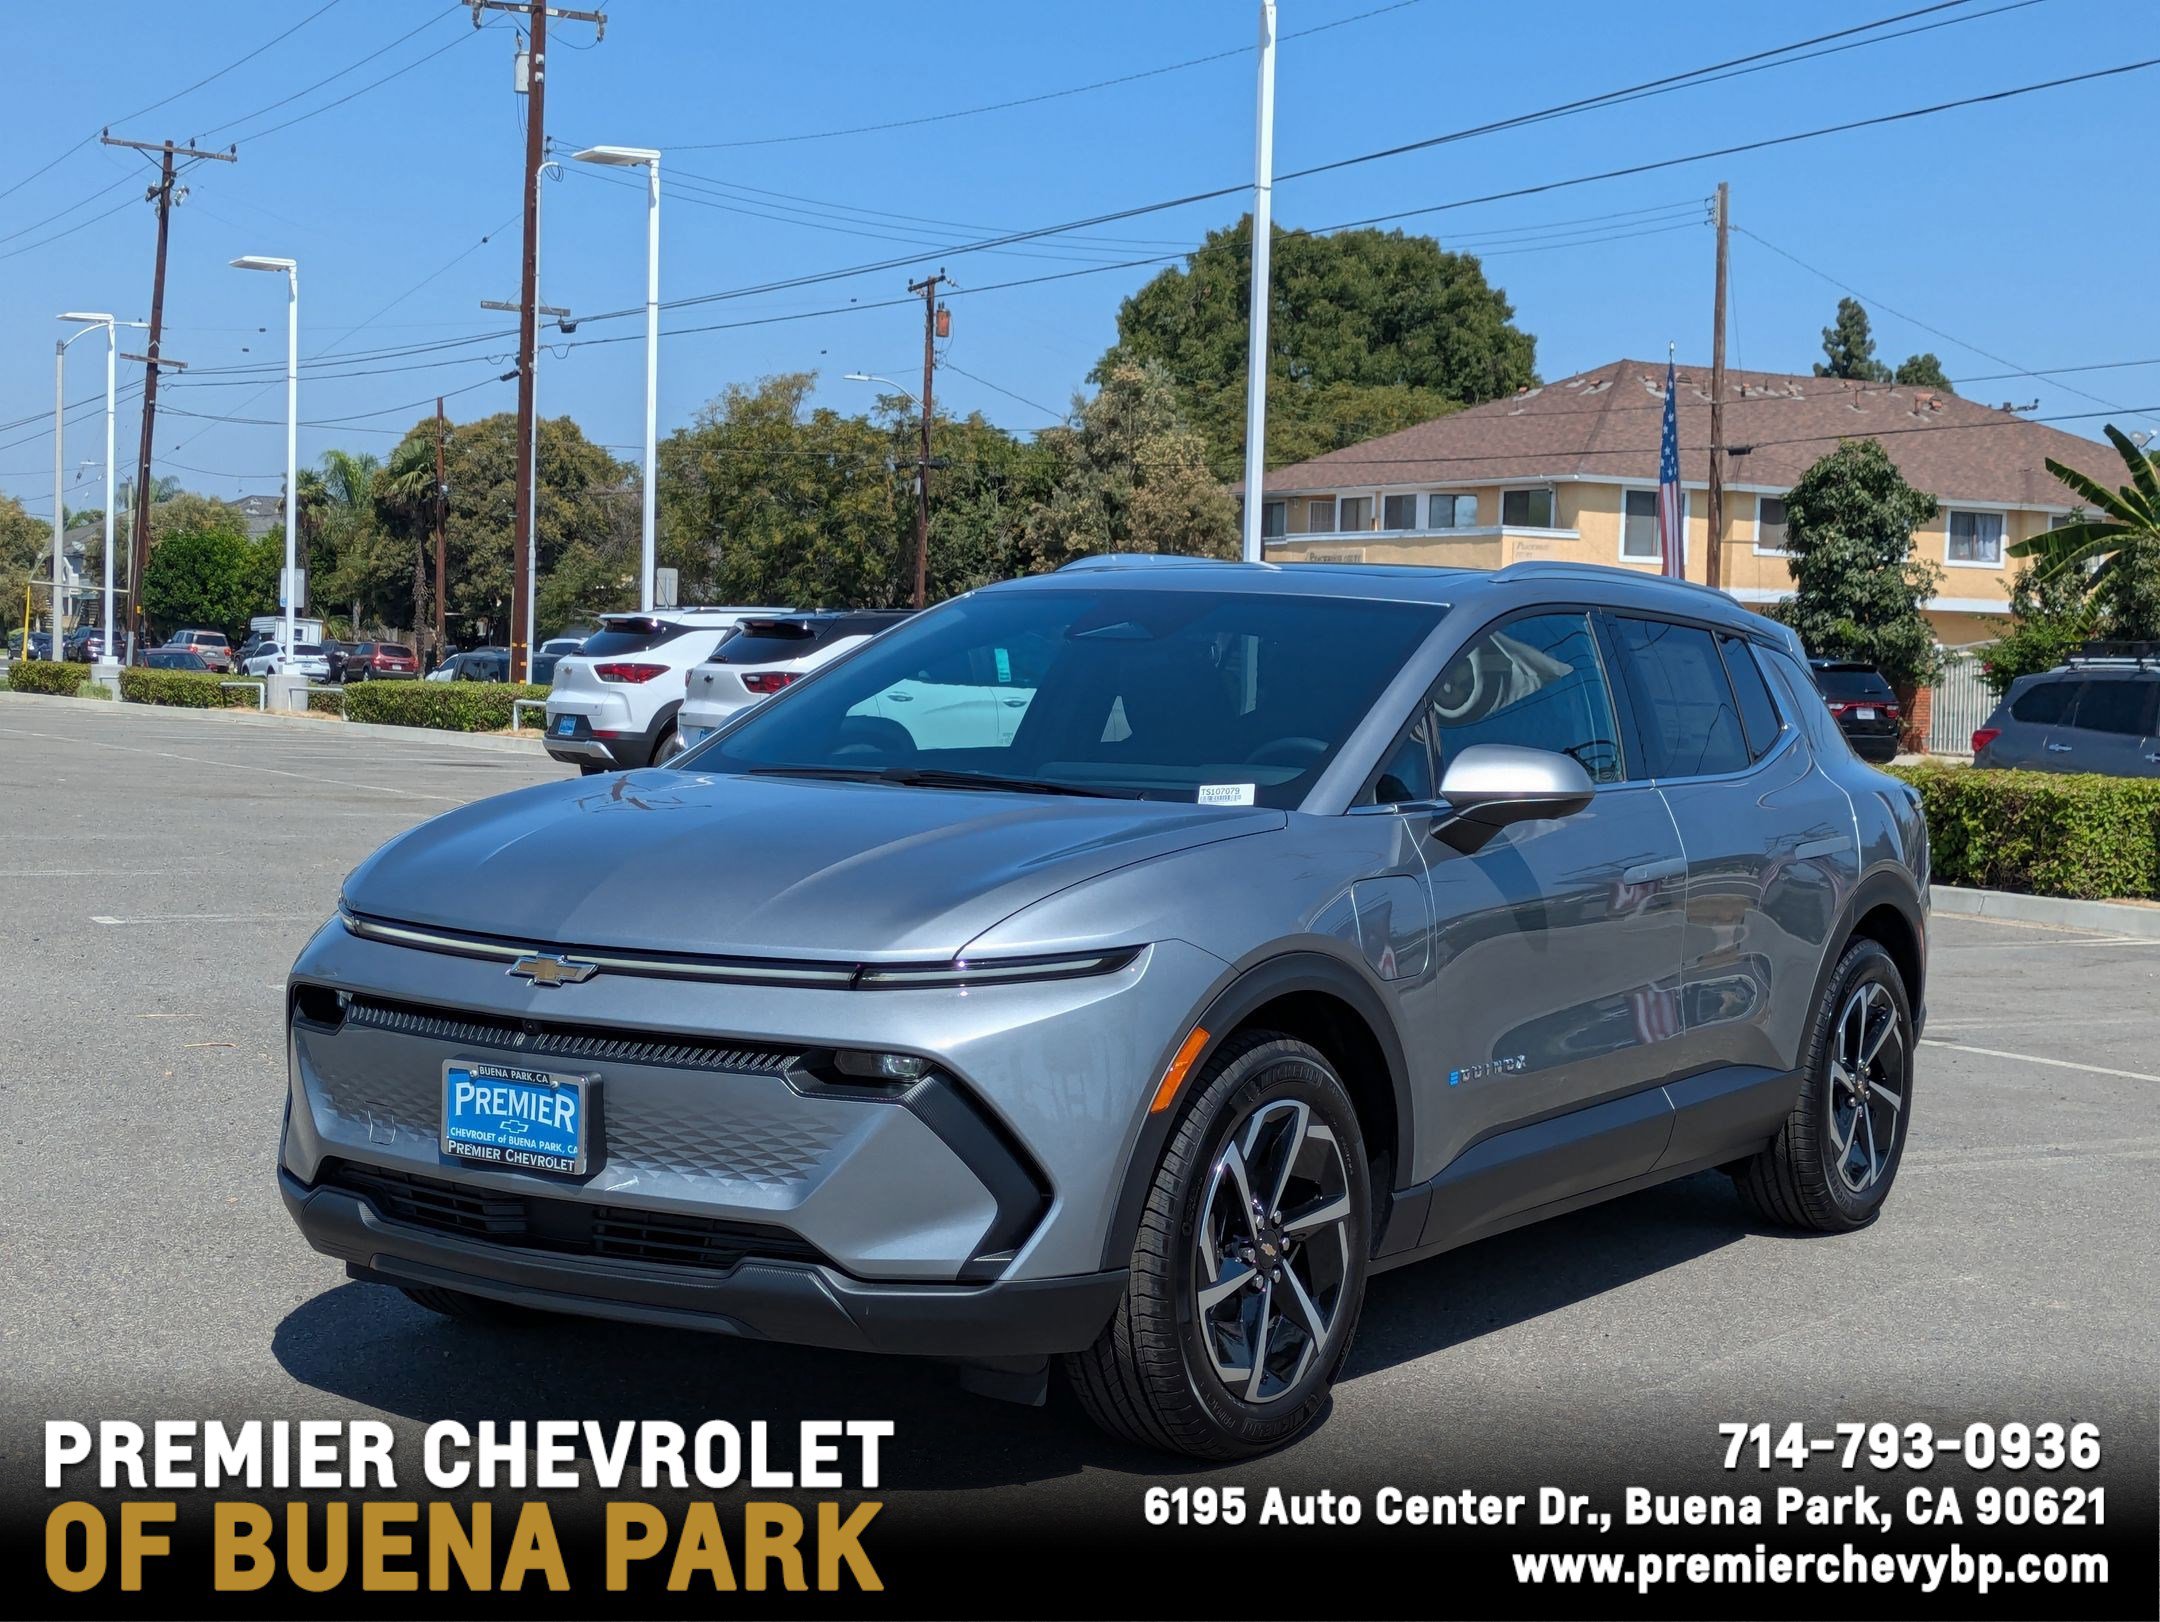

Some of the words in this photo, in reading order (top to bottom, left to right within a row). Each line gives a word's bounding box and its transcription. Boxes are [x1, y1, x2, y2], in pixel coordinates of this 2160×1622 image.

[479, 1066, 508, 1079] BUENA
[455, 1082, 575, 1134] PREMIER
[450, 1127, 497, 1142] CHEVROLET
[498, 1134, 507, 1143] of
[509, 1135, 537, 1148] BUENA
[539, 1140, 564, 1154] PARK,
[448, 1140, 501, 1161] PREMIER
[506, 1149, 575, 1172] CHEVROLET
